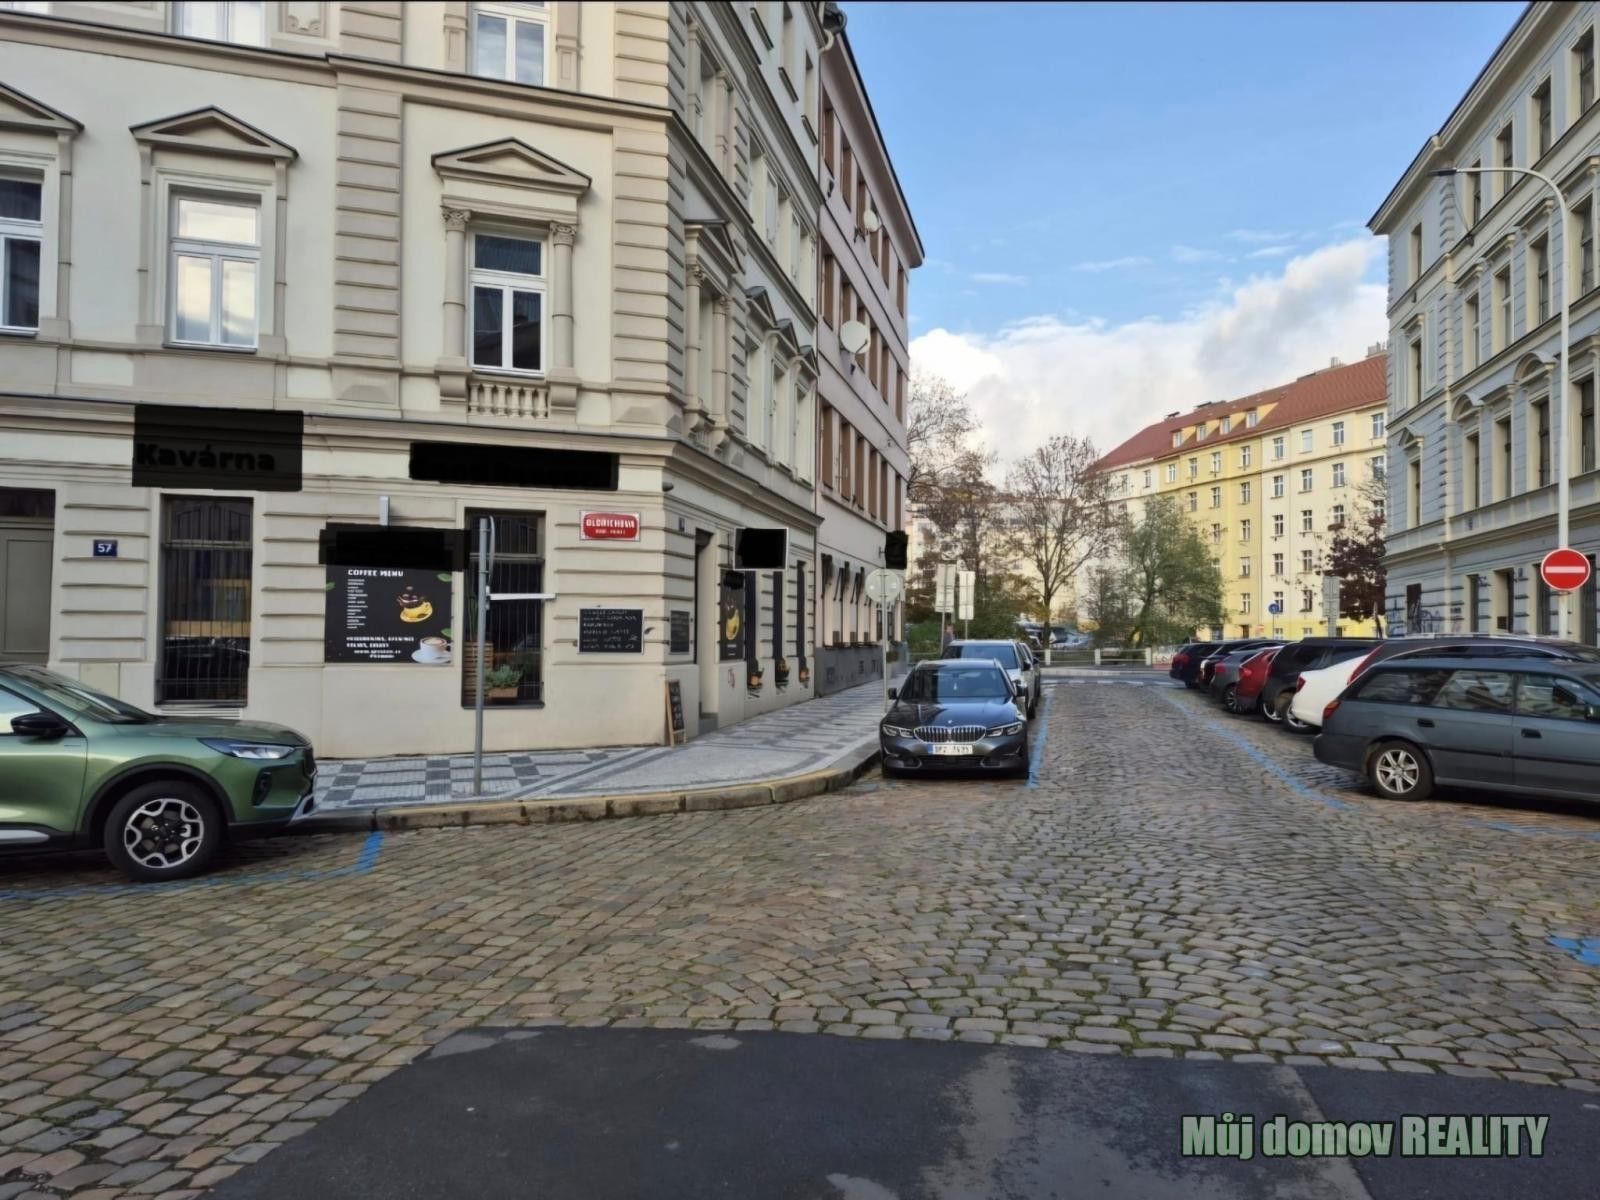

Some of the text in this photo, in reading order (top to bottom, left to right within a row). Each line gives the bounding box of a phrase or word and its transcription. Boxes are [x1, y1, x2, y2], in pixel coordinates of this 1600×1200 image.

[136, 442, 275, 471] Kavárna
[98, 543, 112, 553] 57
[347, 569, 378, 577] COFFEE
